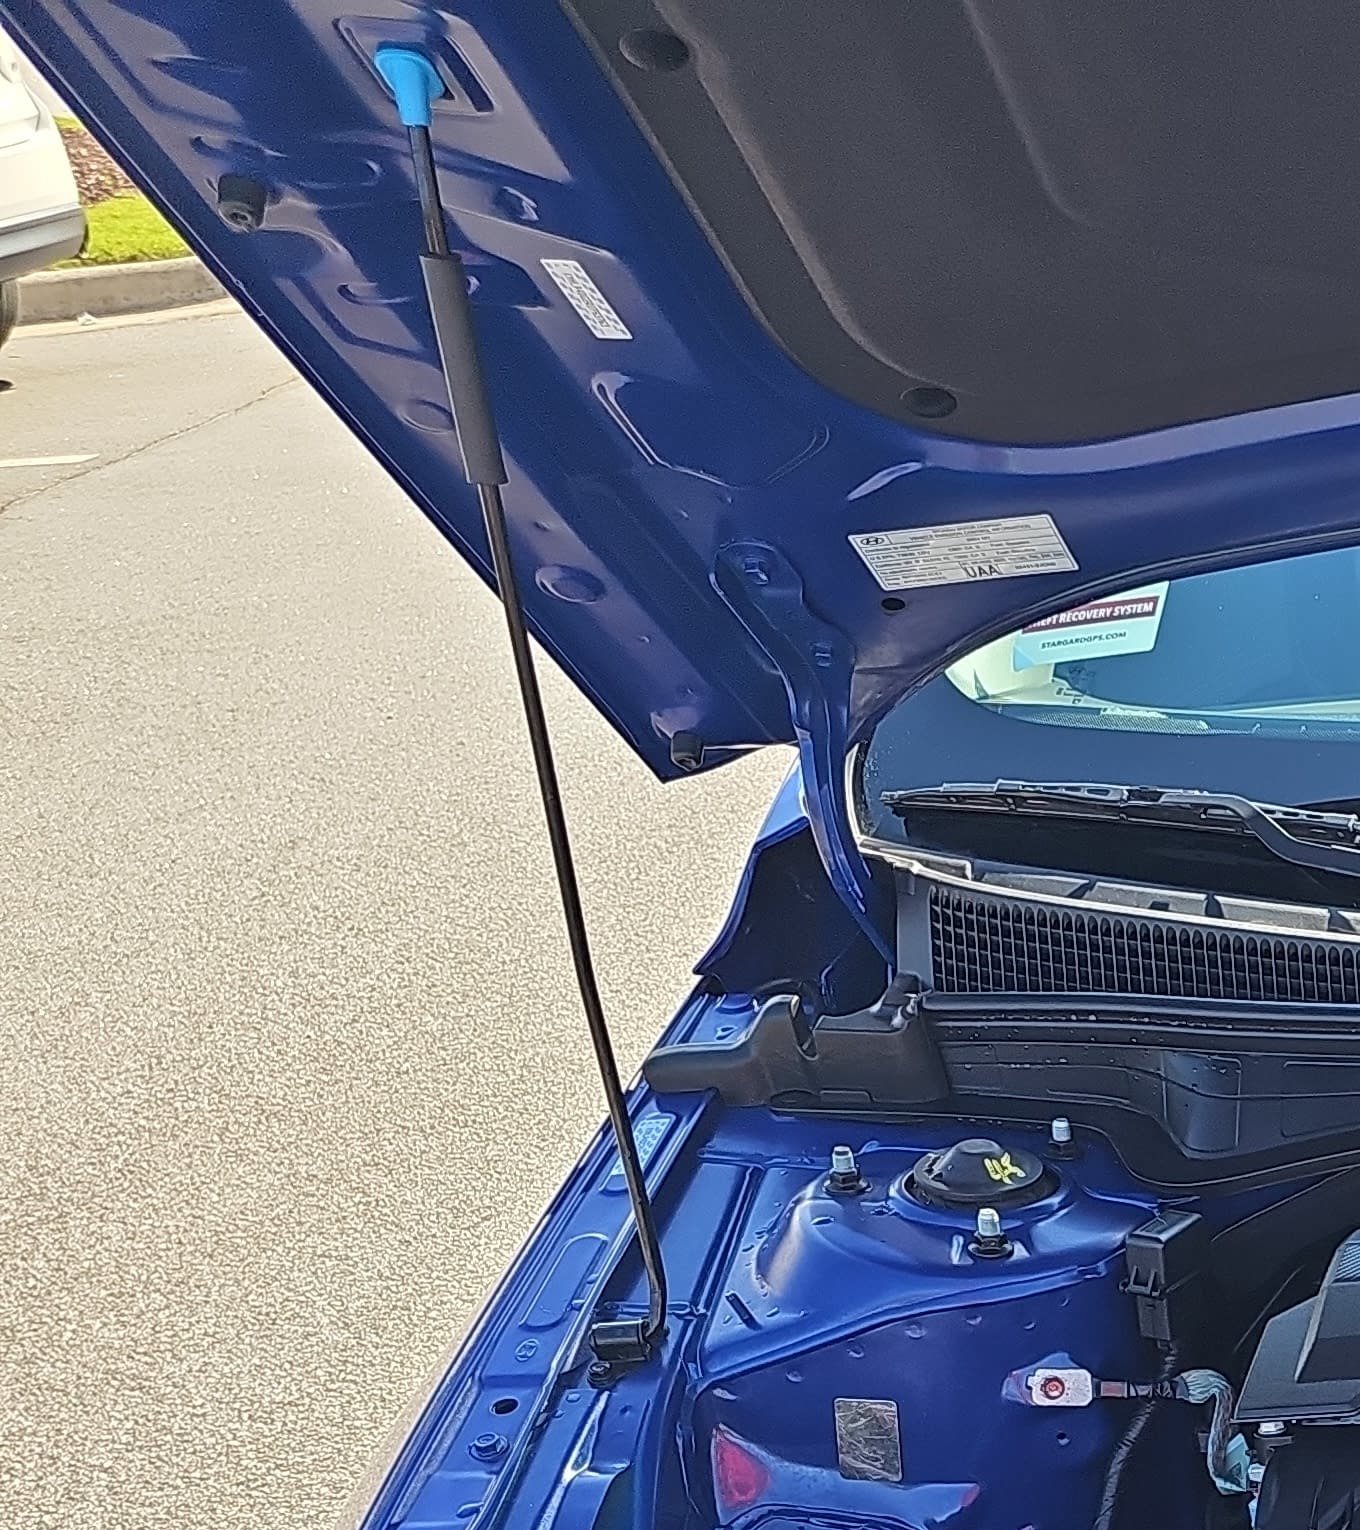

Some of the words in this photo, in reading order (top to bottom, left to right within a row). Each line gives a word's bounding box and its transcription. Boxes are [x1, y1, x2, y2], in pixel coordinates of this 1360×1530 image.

[966, 564, 999, 578] UAA
[1058, 606, 1114, 624] RECOVERY
[1113, 601, 1154, 616] SYSTEM
[1041, 631, 1127, 649] STARGARDGPS.COM
